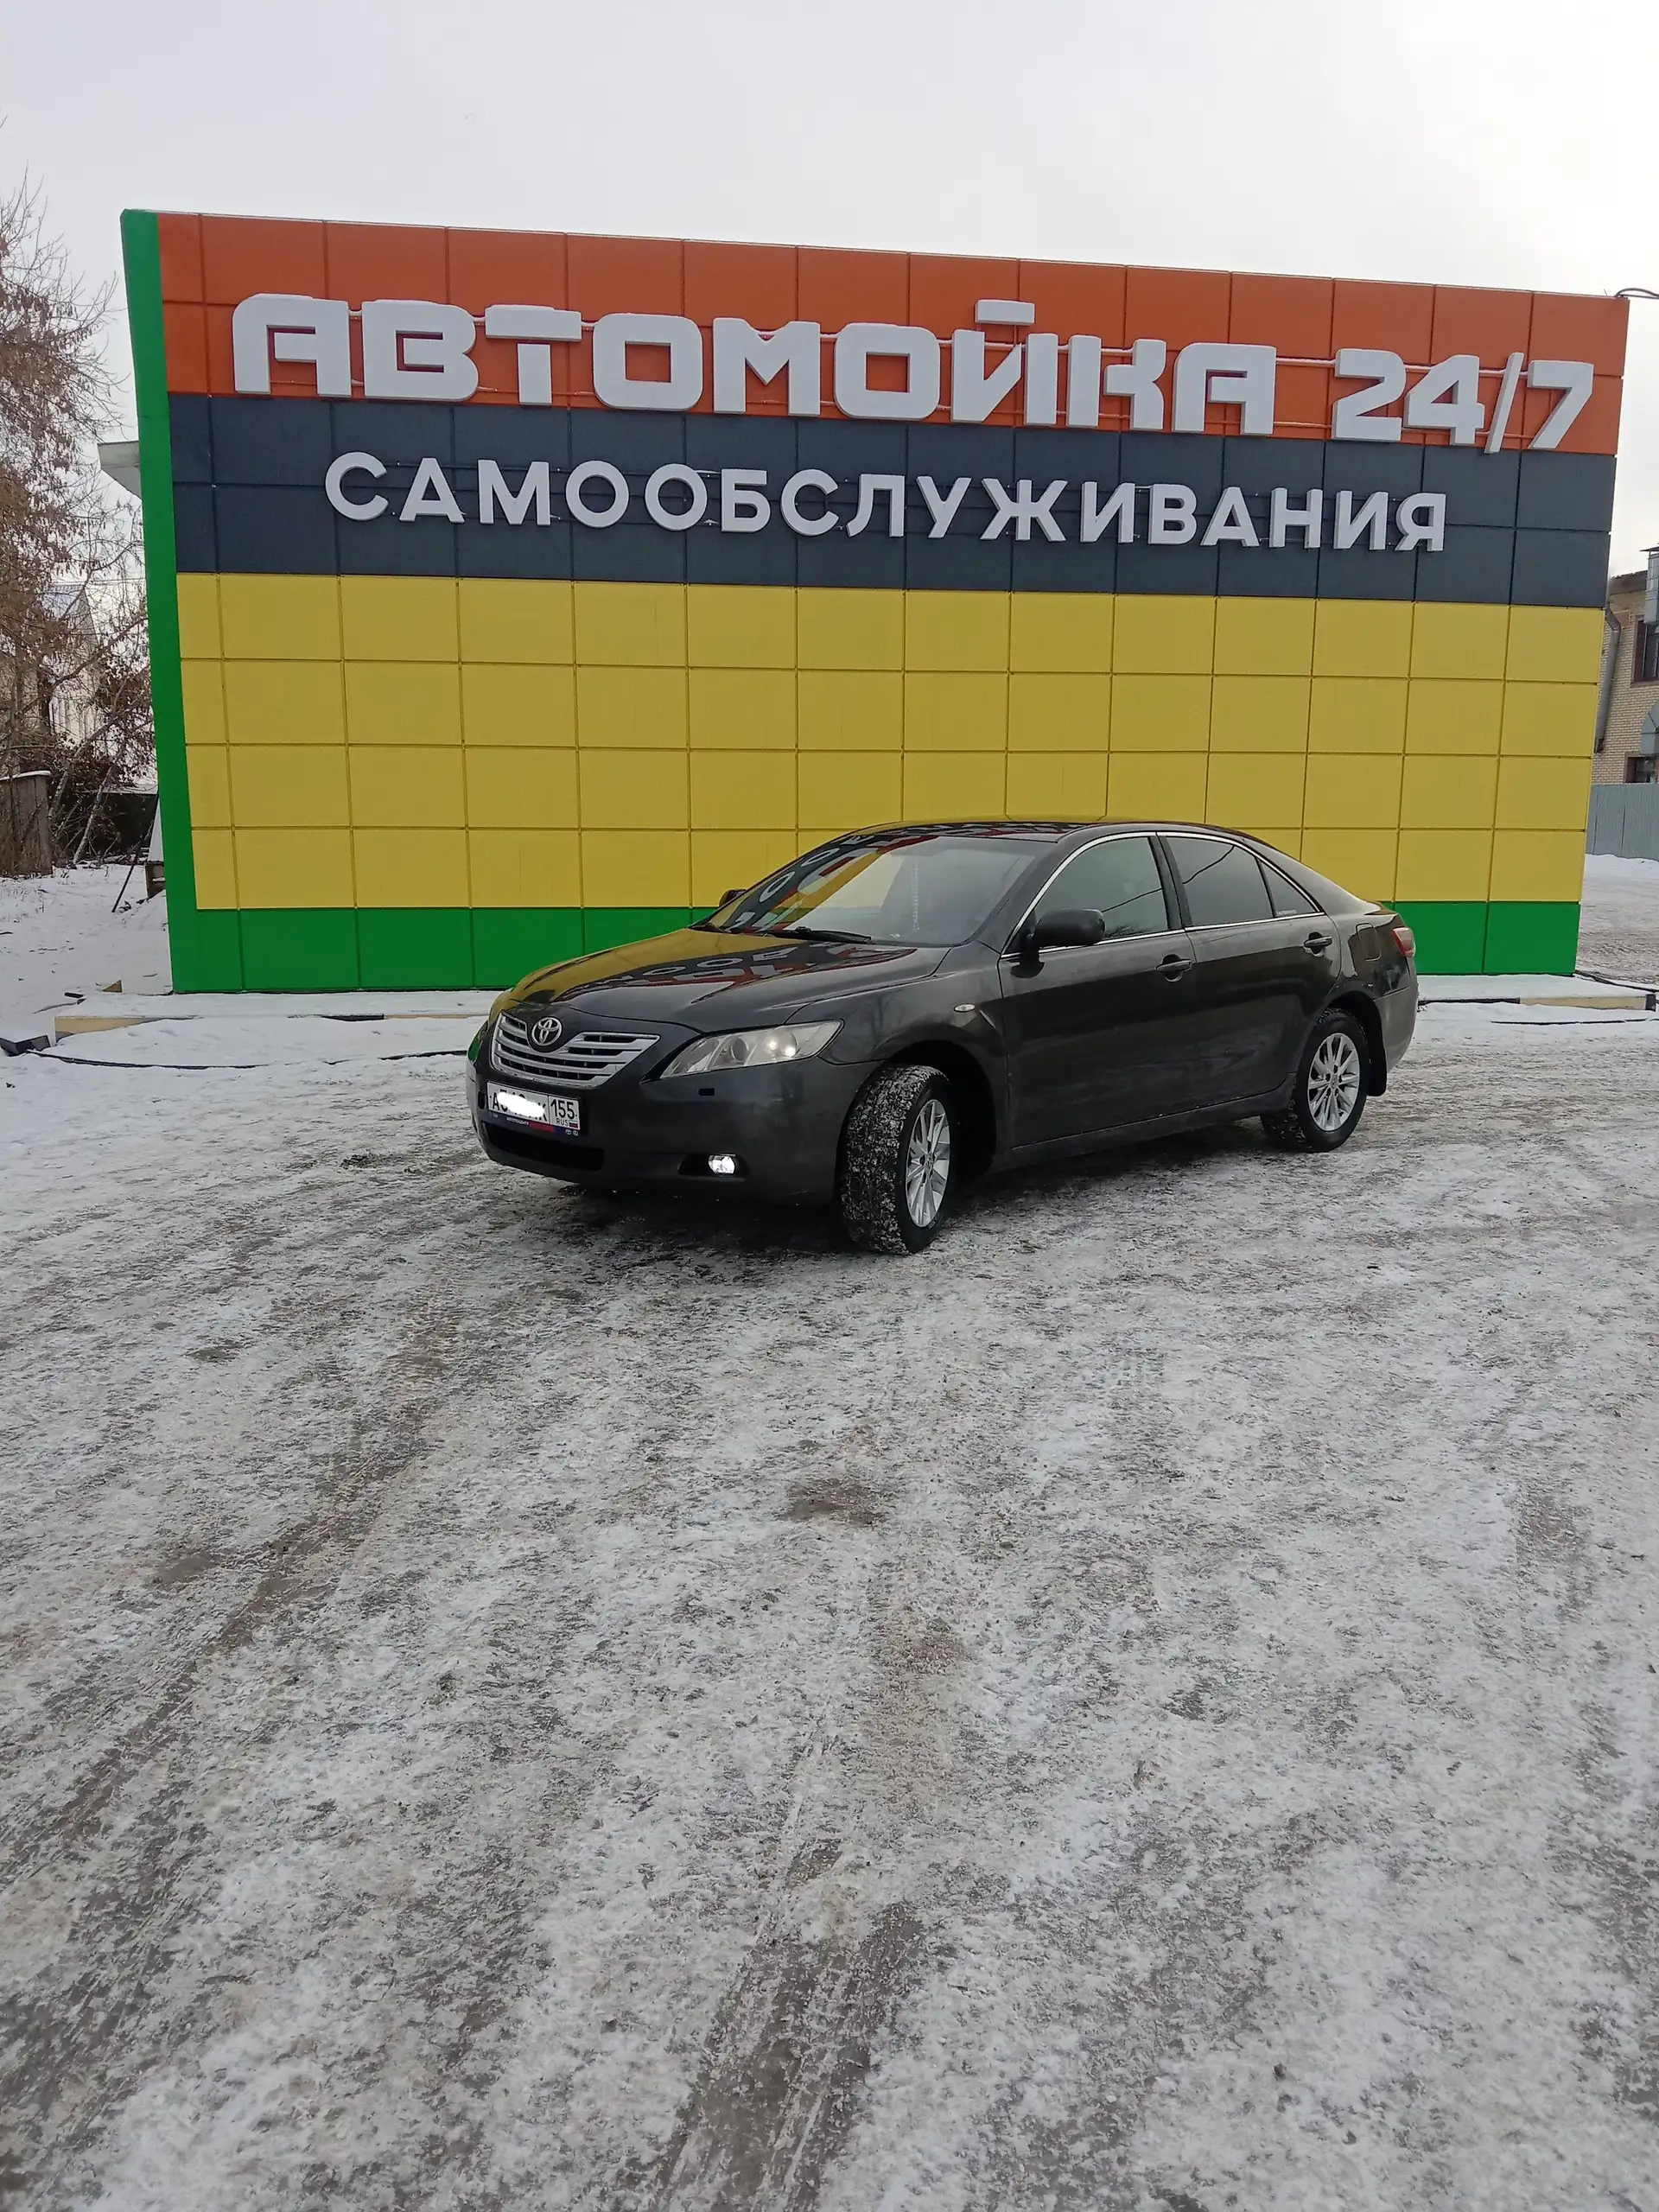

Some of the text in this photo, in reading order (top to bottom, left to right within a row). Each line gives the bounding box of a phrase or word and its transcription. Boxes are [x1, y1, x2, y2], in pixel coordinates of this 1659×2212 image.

[232, 293, 1595, 454] АВТОМОЙКА 24/7
[324, 450, 1447, 552] САМООБСЛУЖИВАНИЯ
[550, 1099, 575, 1119] 155
